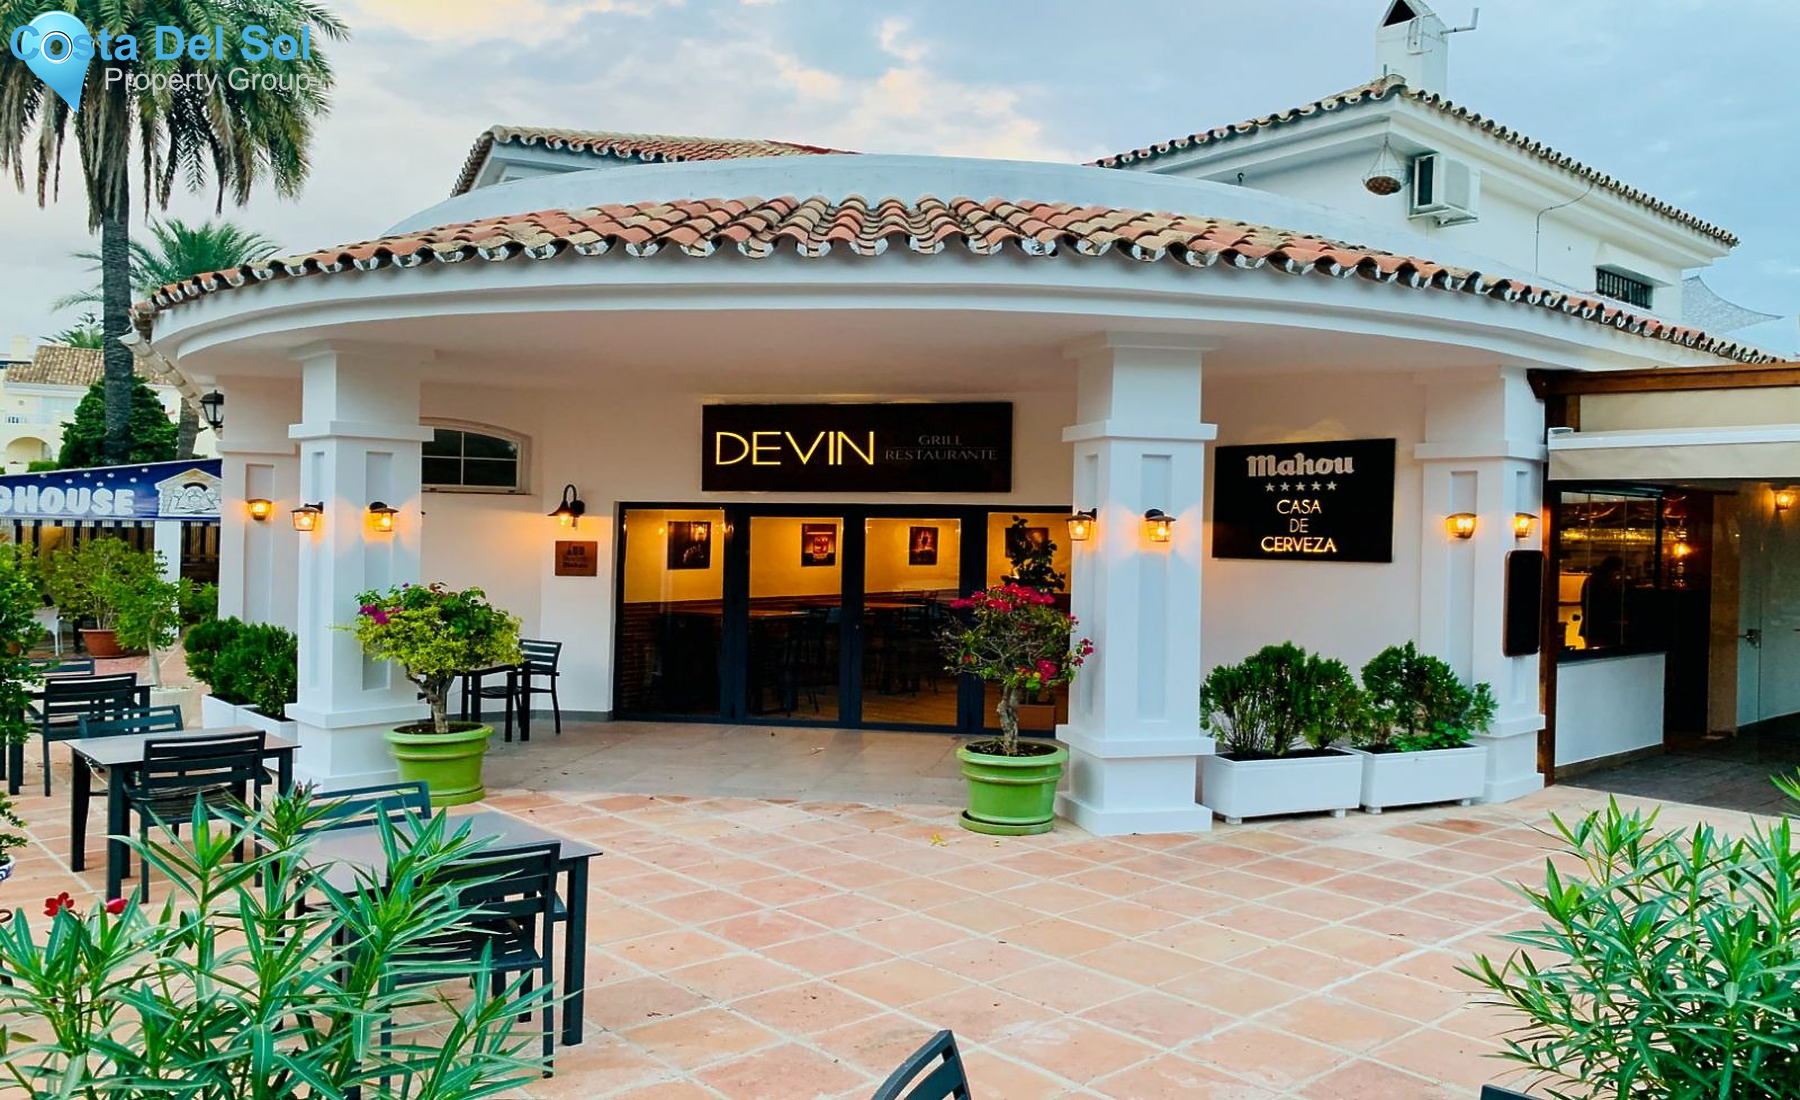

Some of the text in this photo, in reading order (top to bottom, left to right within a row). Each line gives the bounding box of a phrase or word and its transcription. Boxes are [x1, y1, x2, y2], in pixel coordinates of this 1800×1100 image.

[918, 434, 963, 446] GRILL
[715, 430, 875, 466] DEVIN
[885, 448, 998, 461] RESTAURANTE
[1246, 452, 1355, 477] Mahou
[1276, 499, 1322, 514] CASA
[1289, 518, 1309, 533] DE
[1261, 536, 1337, 553] CERVEZA
